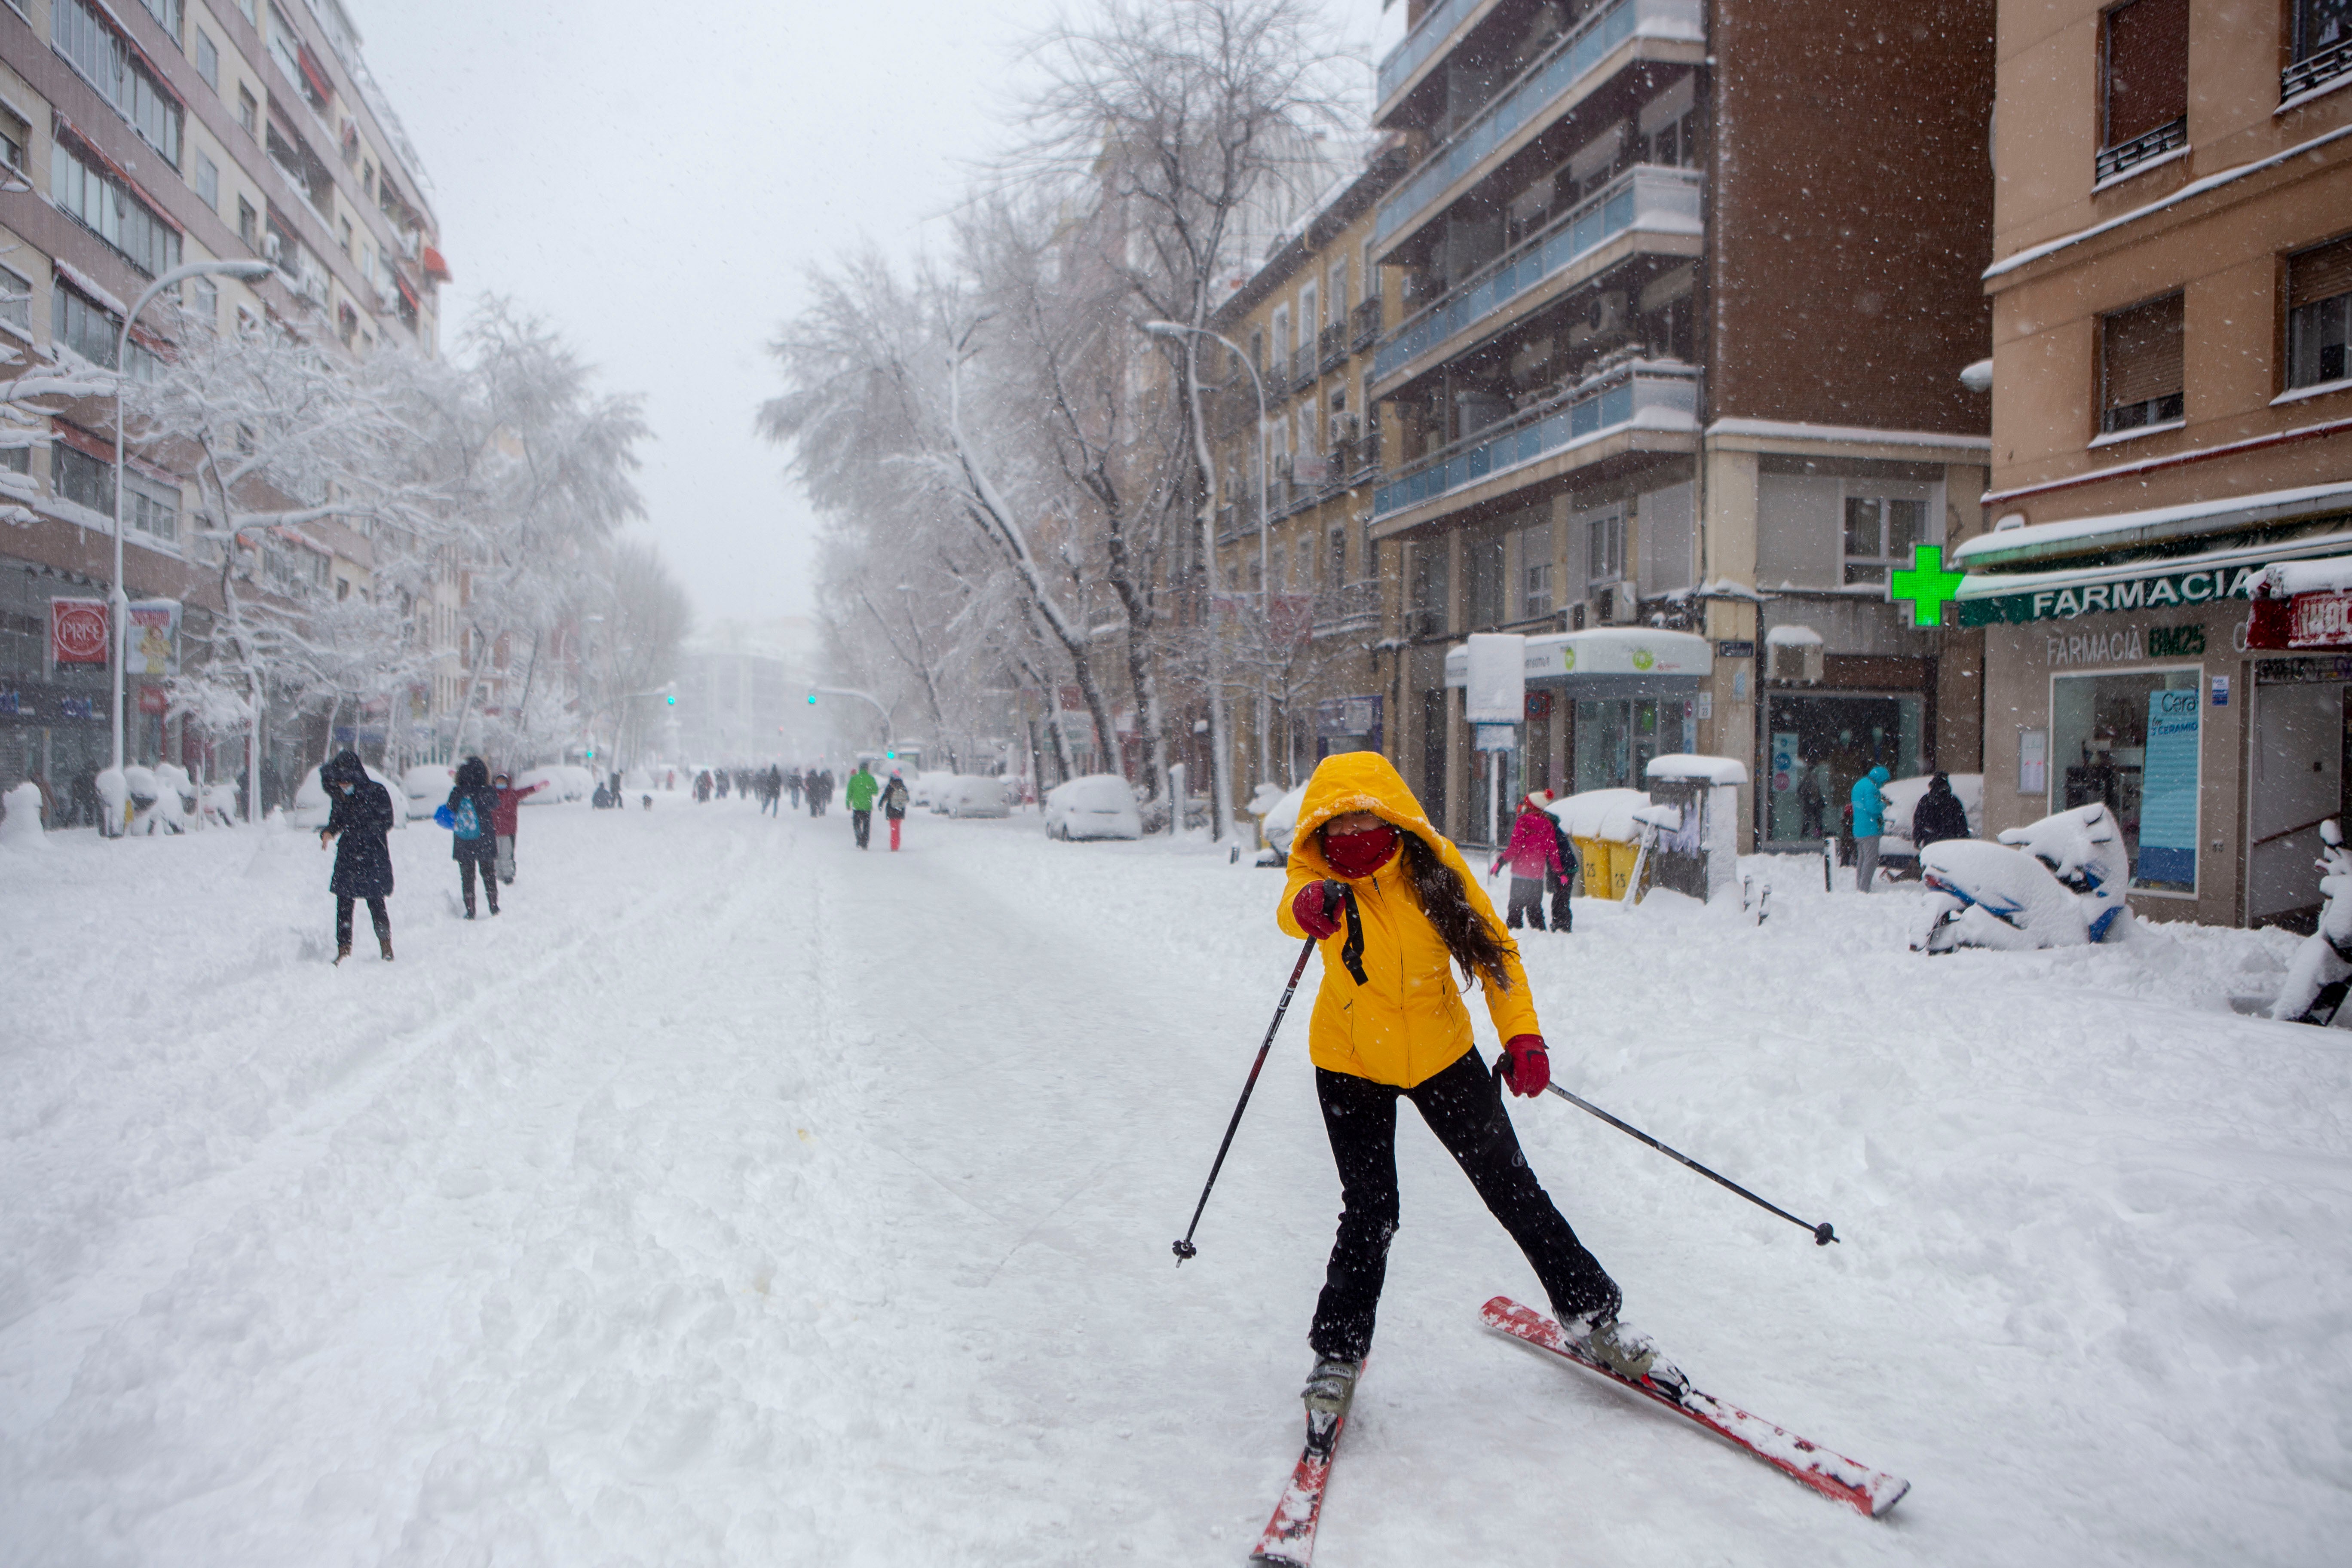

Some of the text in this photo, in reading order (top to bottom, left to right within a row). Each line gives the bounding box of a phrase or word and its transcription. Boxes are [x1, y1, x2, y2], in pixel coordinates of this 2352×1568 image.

[2033, 567, 2253, 618] FARMACIA
[2047, 631, 2143, 666] FARMACIA
[2149, 624, 2206, 657] BM25
